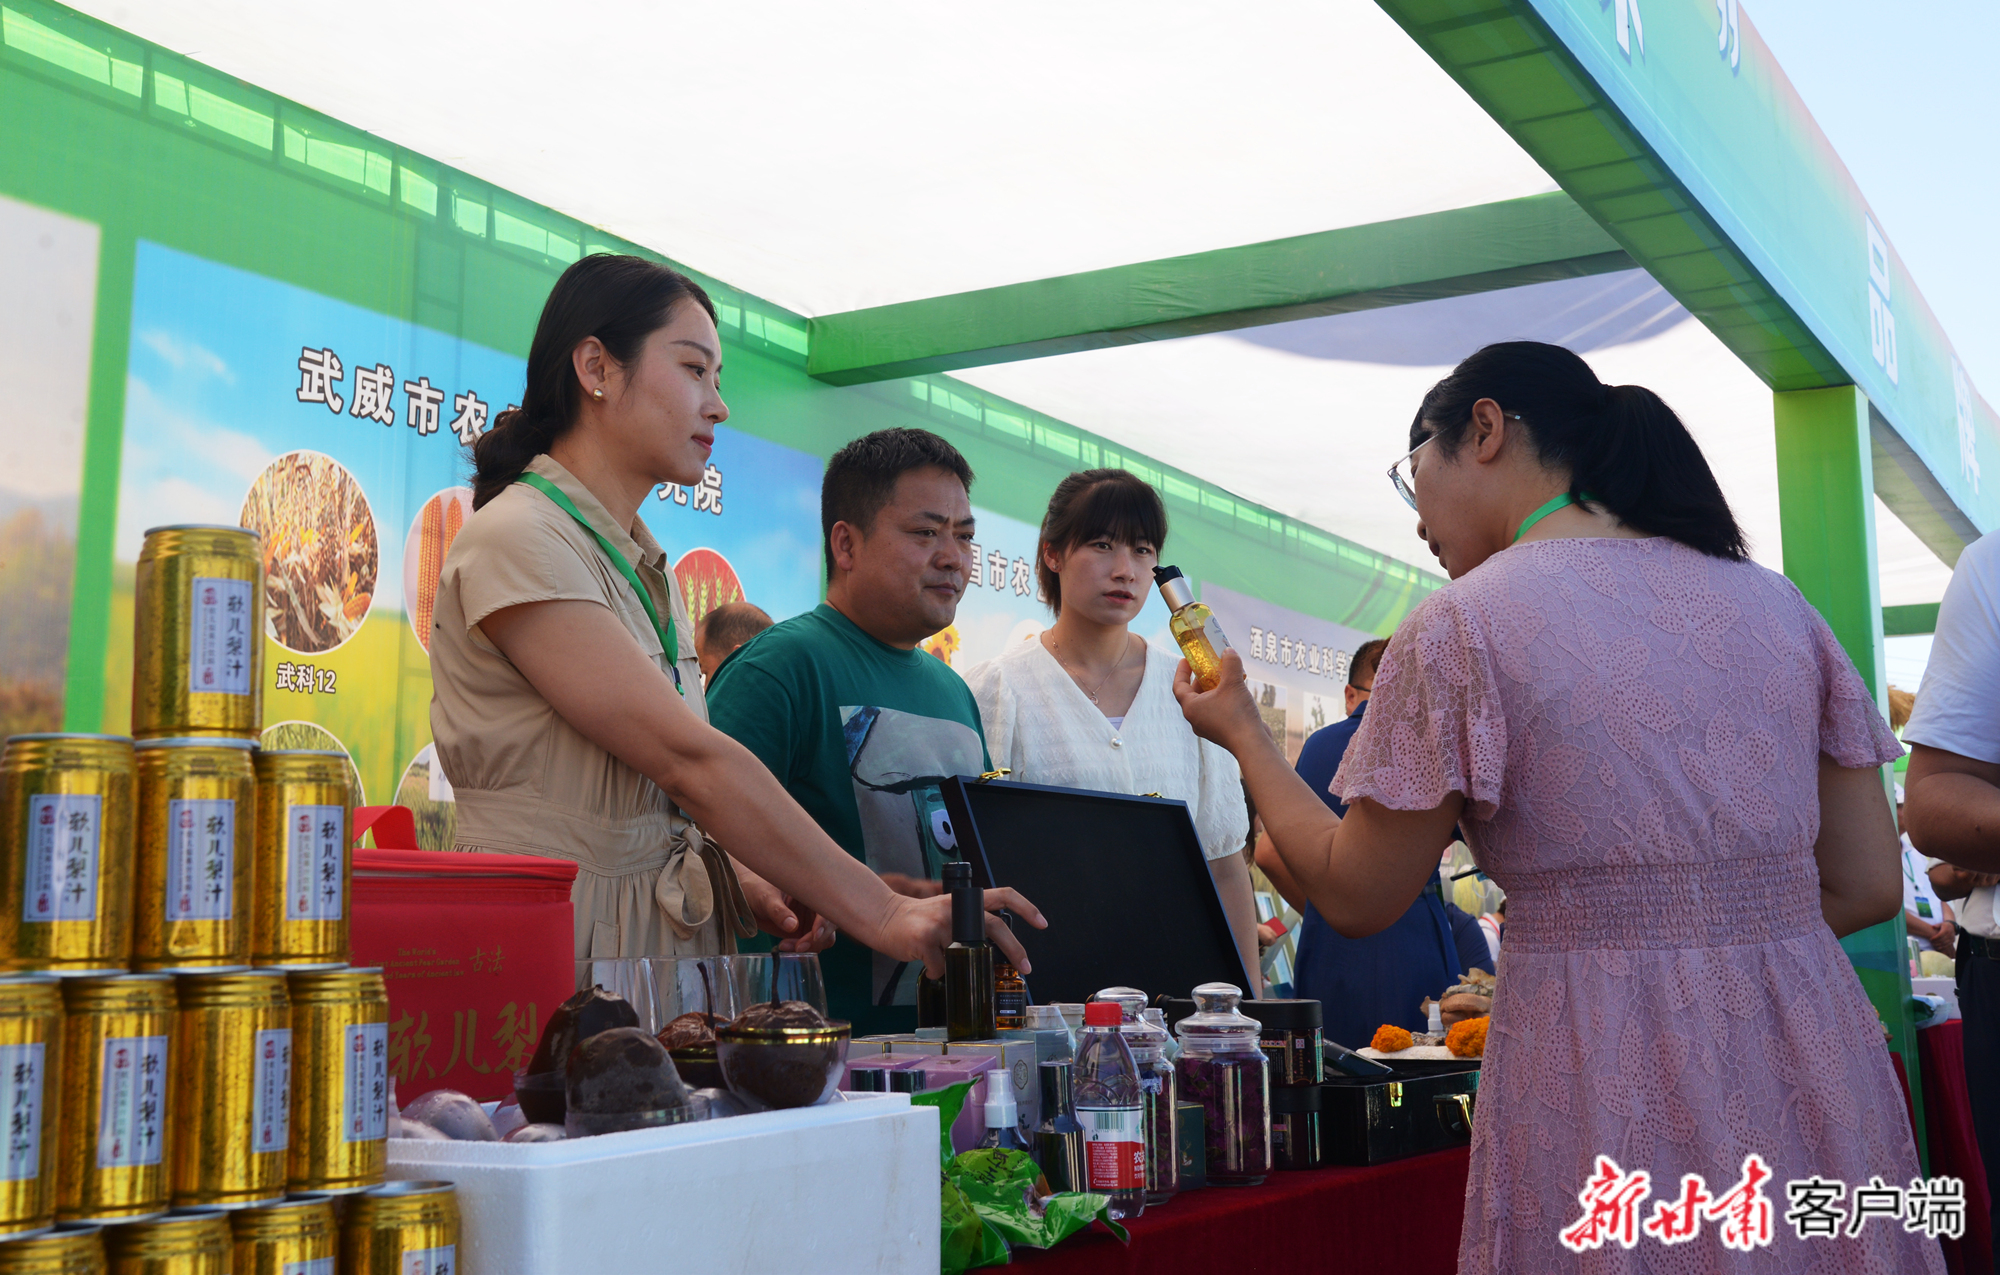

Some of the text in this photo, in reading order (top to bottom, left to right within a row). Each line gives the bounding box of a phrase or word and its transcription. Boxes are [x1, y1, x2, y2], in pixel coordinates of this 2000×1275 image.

[297, 346, 522, 447] 武威市农
[969, 542, 1047, 604] 昌市农
[276, 661, 337, 694] 武科12
[1250, 625, 1354, 682] 酒泉市农业科学
[205, 815, 227, 903] 软儿梨汁
[320, 821, 338, 904] 软儿梨汁
[469, 944, 506, 974] 古法
[389, 1001, 538, 1086] 软儿梨
